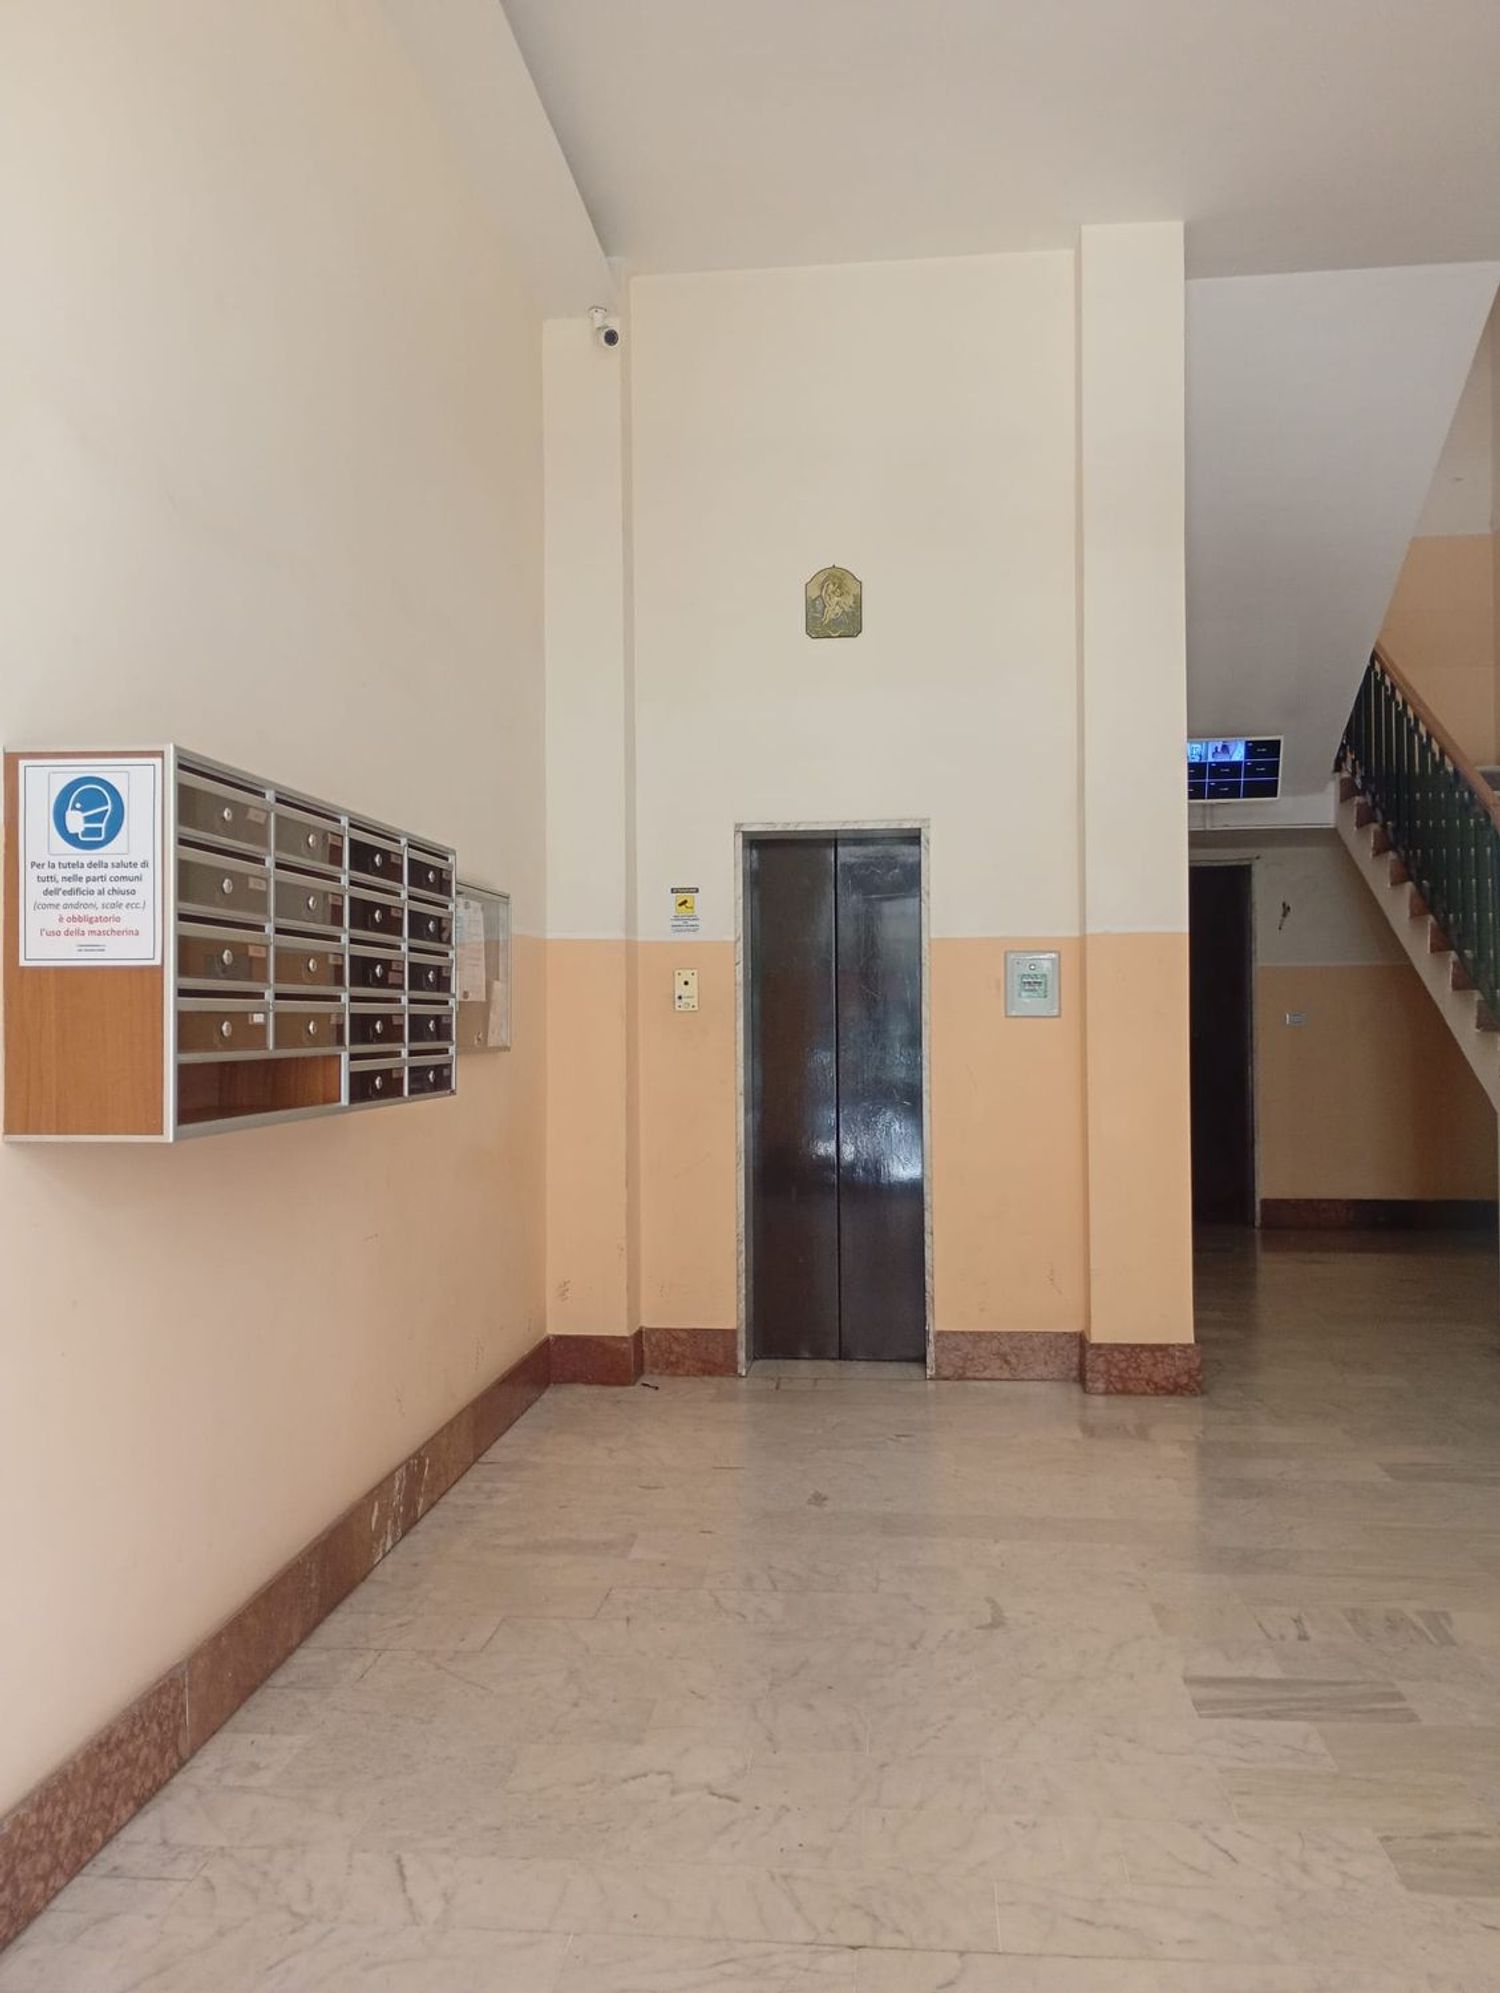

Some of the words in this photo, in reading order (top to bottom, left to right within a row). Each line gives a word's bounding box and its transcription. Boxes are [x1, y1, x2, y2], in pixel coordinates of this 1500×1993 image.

[30, 860, 44, 869] Per
[48, 860, 55, 869] la
[58, 860, 84, 869] tutela
[87, 861, 108, 869] della
[111, 860, 138, 869] salute
[141, 860, 148, 868] di
[37, 875, 59, 883] tutti,
[85, 874, 107, 884] parti
[109, 874, 142, 882] comuni
[97, 888, 104, 896] al
[33, 902, 60, 911] (come
[63, 902, 98, 910] androni,
[125, 901, 146, 910] ecc.)
[58, 915, 63, 923] è
[66, 914, 121, 924] obbligatorio
[88, 928, 139, 936] mascherina
